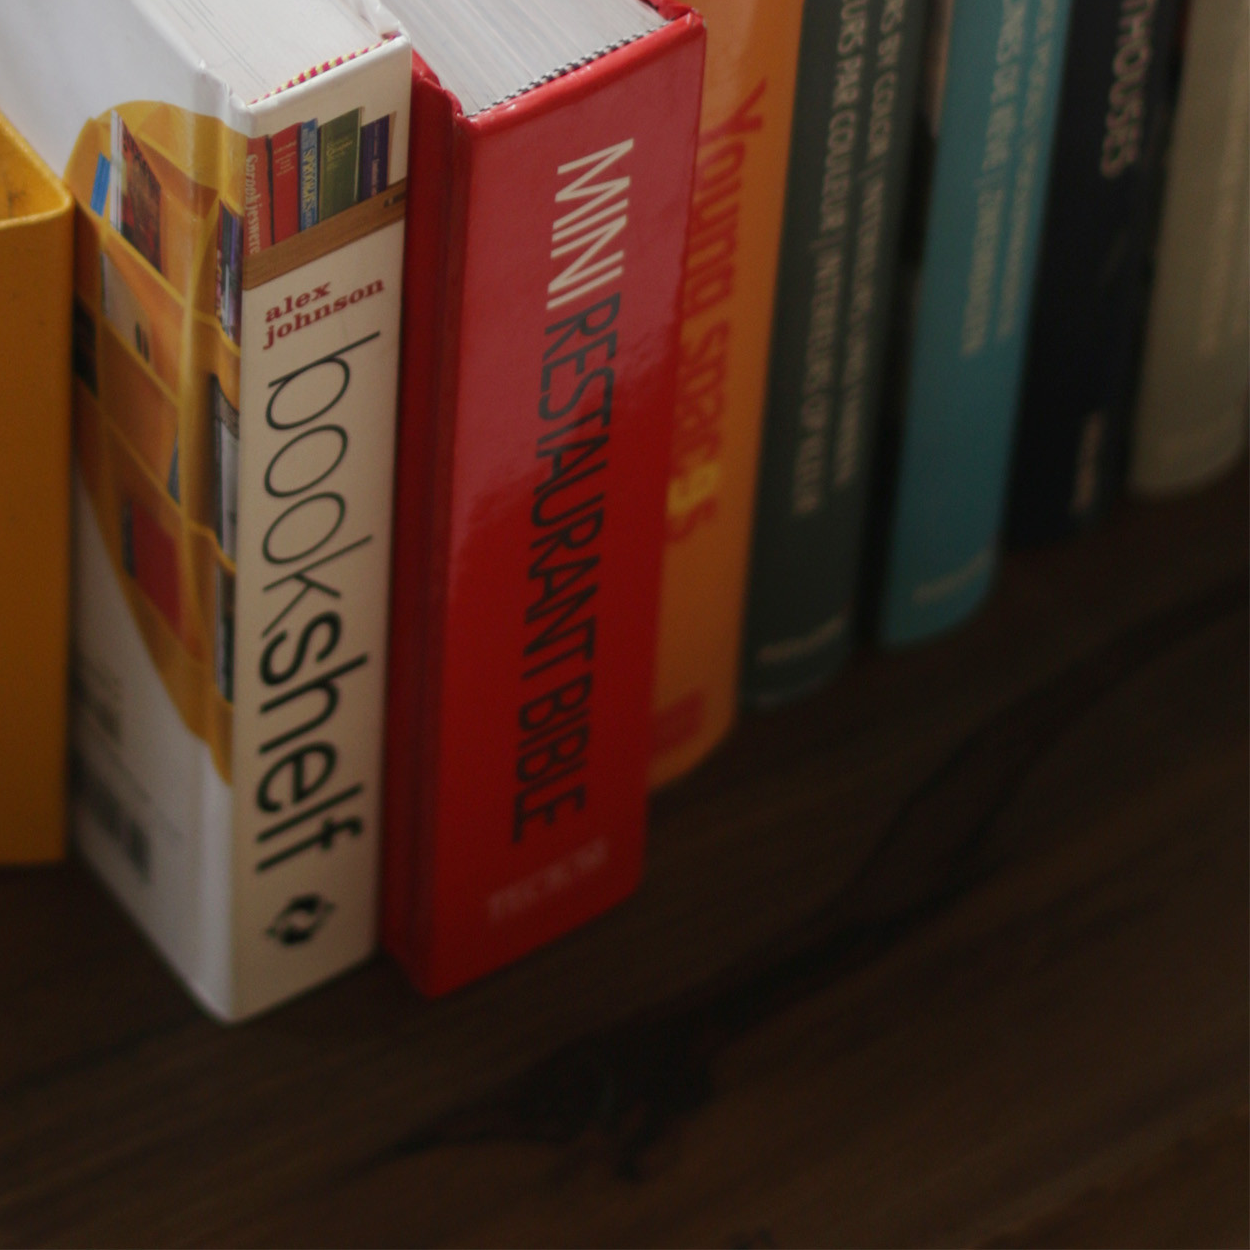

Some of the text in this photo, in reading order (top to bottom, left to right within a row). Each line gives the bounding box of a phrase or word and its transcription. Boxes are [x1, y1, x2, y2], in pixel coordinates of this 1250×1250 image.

[832, 53, 864, 110] PAR
[264, 281, 332, 324] alex
[546, 137, 635, 311] MINI
[262, 279, 386, 351] johnson
[521, 291, 622, 681] RESTAURANT
[255, 329, 381, 875] bookshelf
[511, 670, 594, 844] BIBLE
